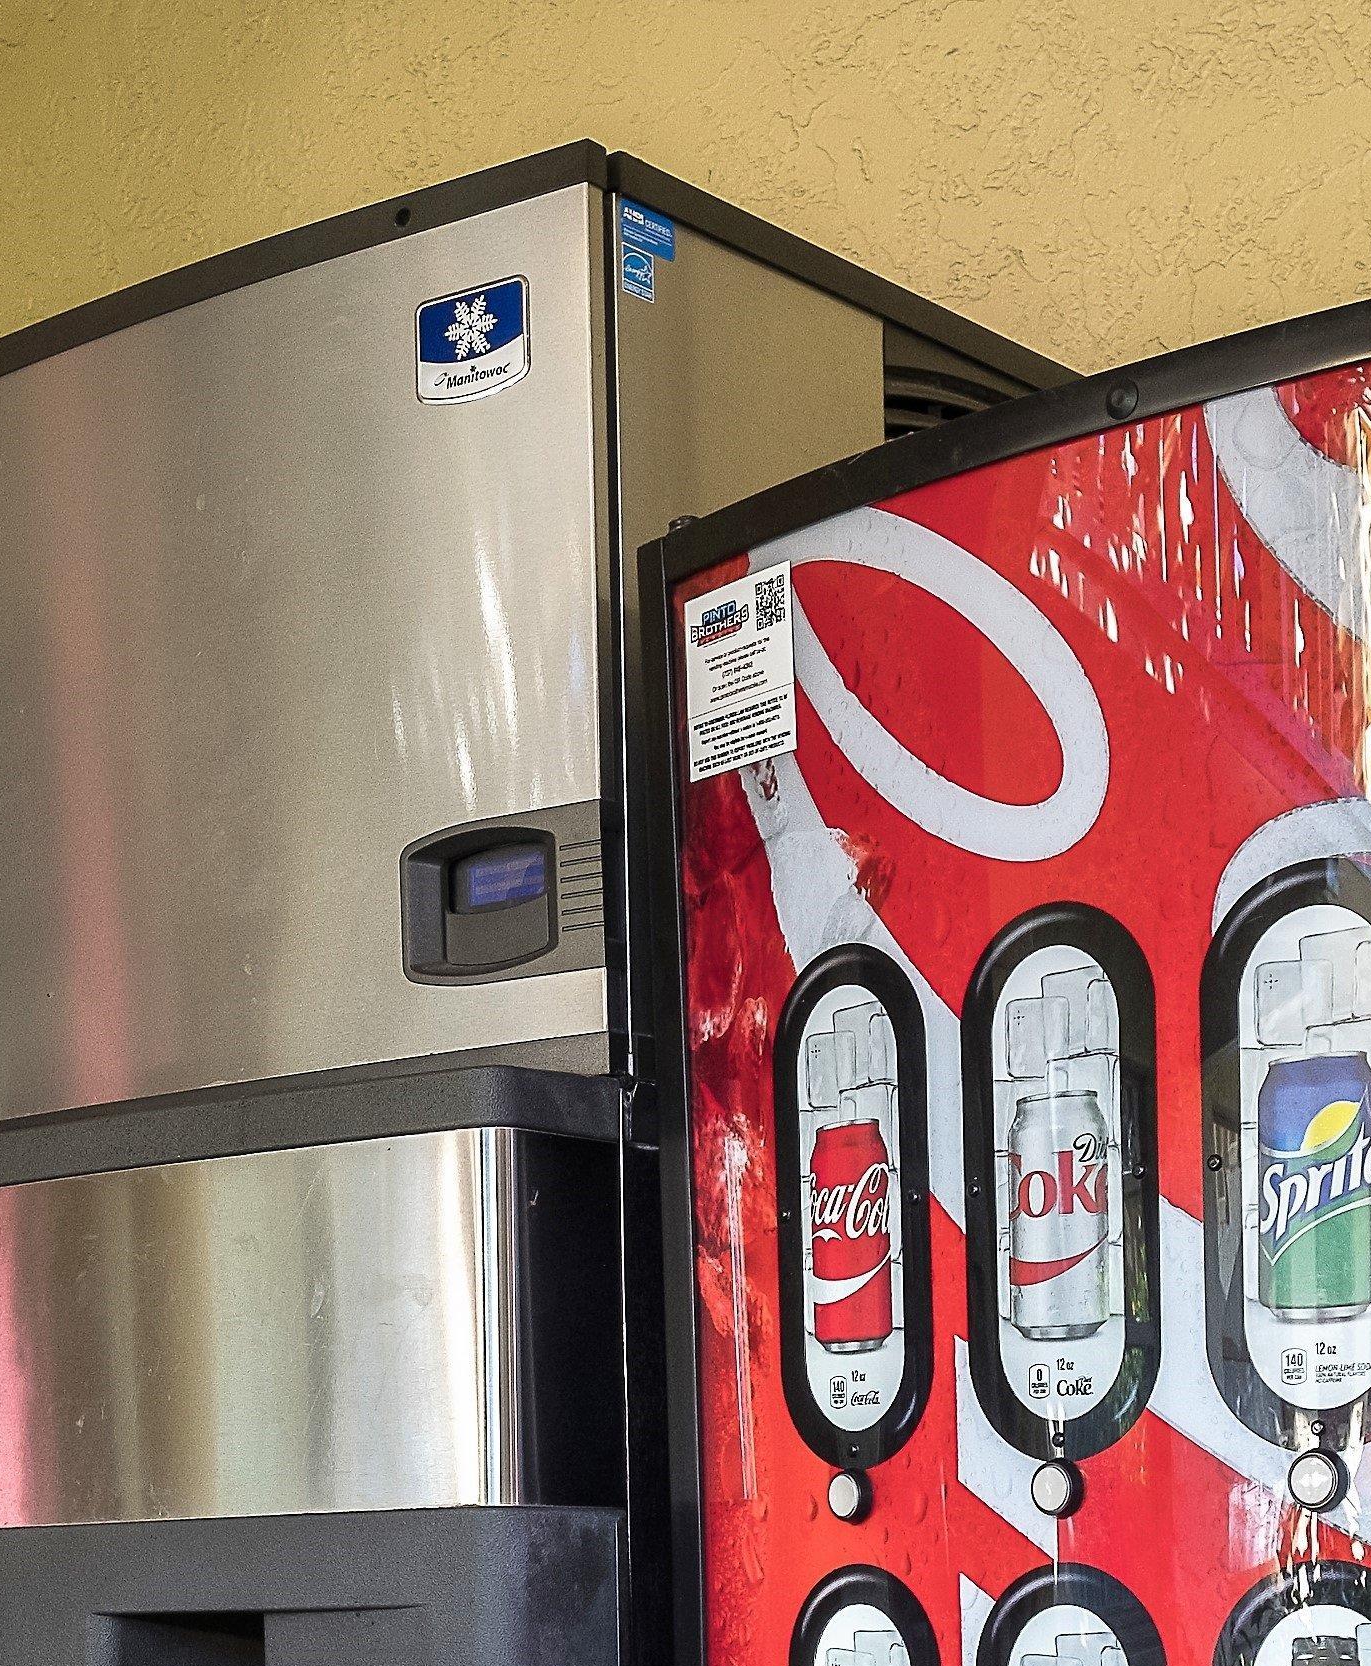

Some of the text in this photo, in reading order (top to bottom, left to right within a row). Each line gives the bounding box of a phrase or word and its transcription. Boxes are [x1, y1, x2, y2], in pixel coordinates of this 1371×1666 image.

[447, 363, 510, 389] Manitowoc
[691, 604, 749, 642] BROTHERS
[702, 601, 736, 624] PINTO
[809, 1163, 890, 1239] oca-Col
[1286, 1342, 1336, 1366] 140 12 oz
[1037, 1358, 1074, 1381] 0 12 oz
[1057, 1380, 1093, 1396] Coke
